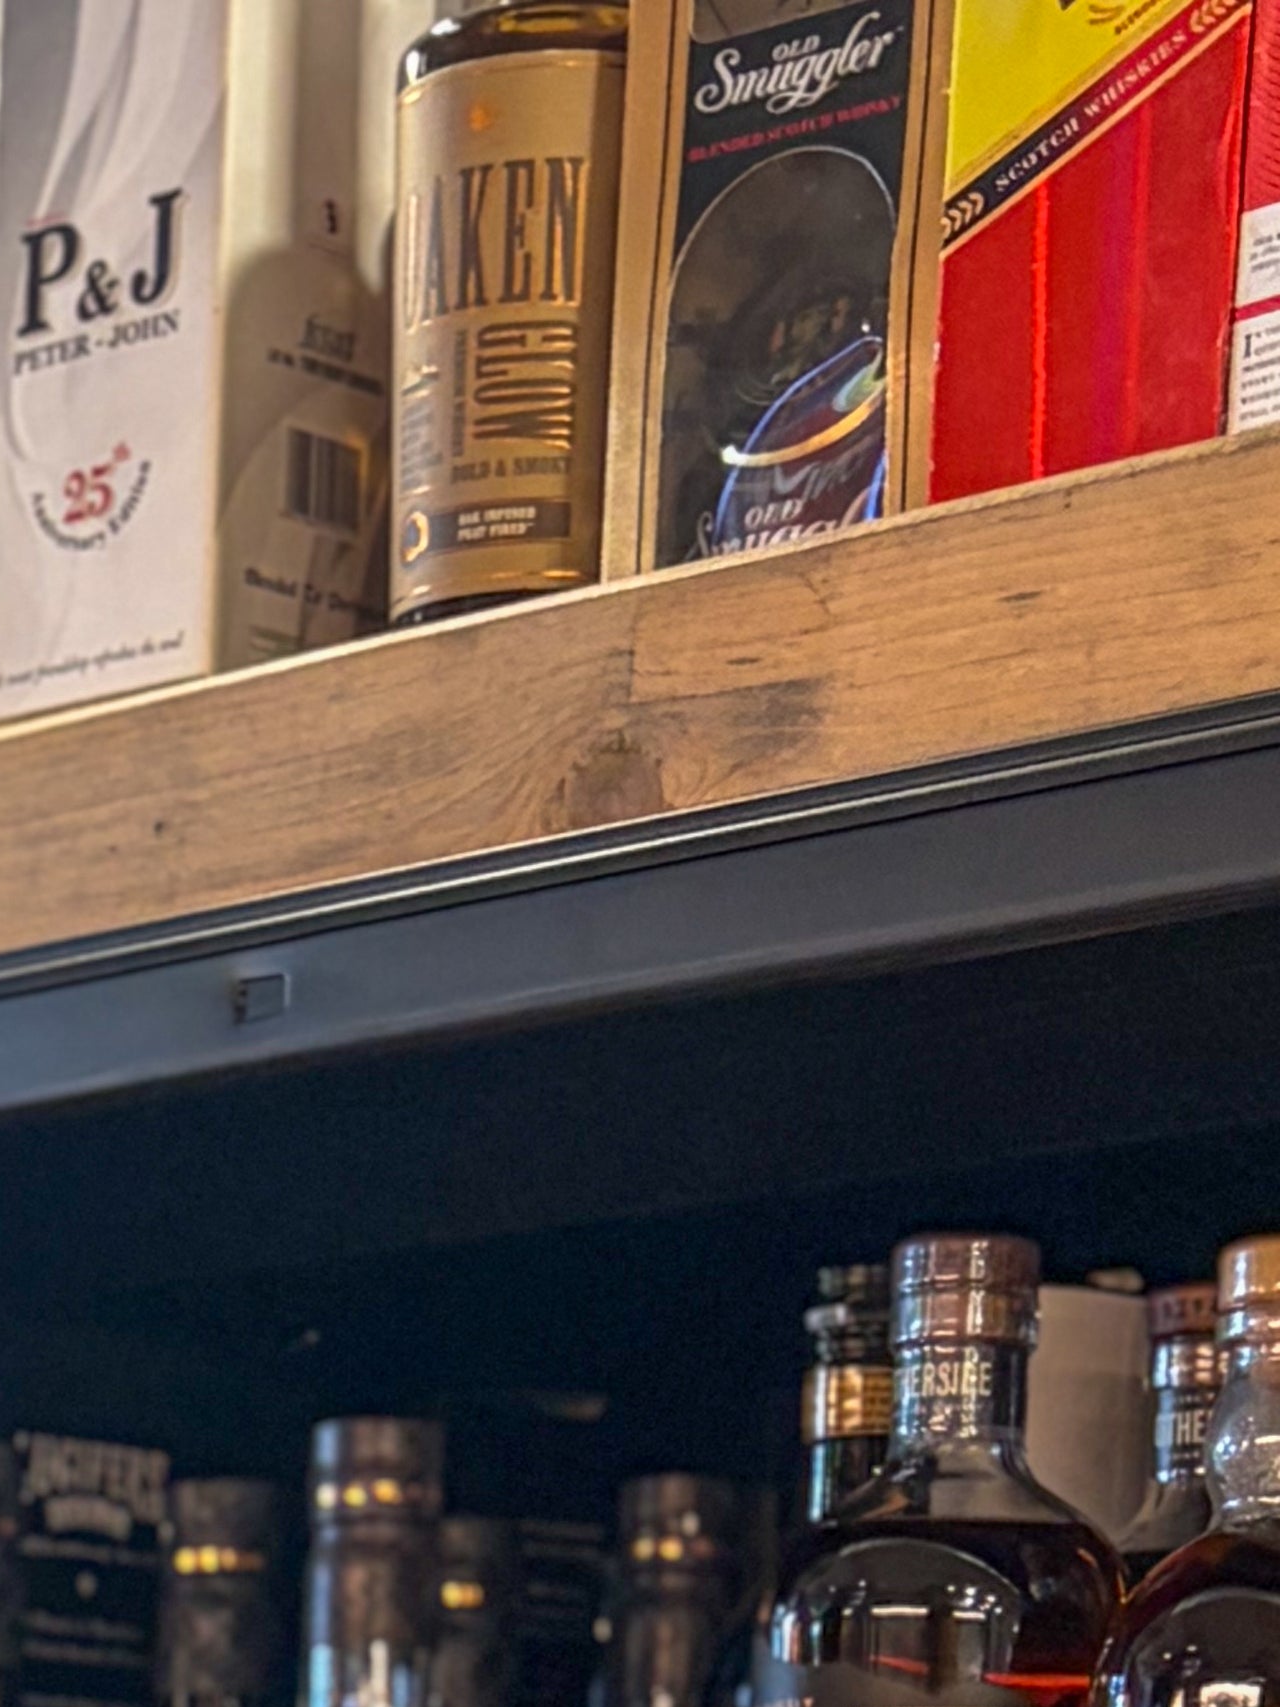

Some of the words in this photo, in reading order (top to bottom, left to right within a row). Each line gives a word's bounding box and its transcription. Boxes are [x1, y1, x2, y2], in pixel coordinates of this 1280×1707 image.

[694, 11, 895, 115] Smuggler
[771, 35, 820, 61] OLD
[994, 117, 1080, 192] SCOTCH
[1083, 29, 1188, 120] WHISKIES
[17, 186, 183, 338] P&J
[743, 498, 805, 531] OLD
